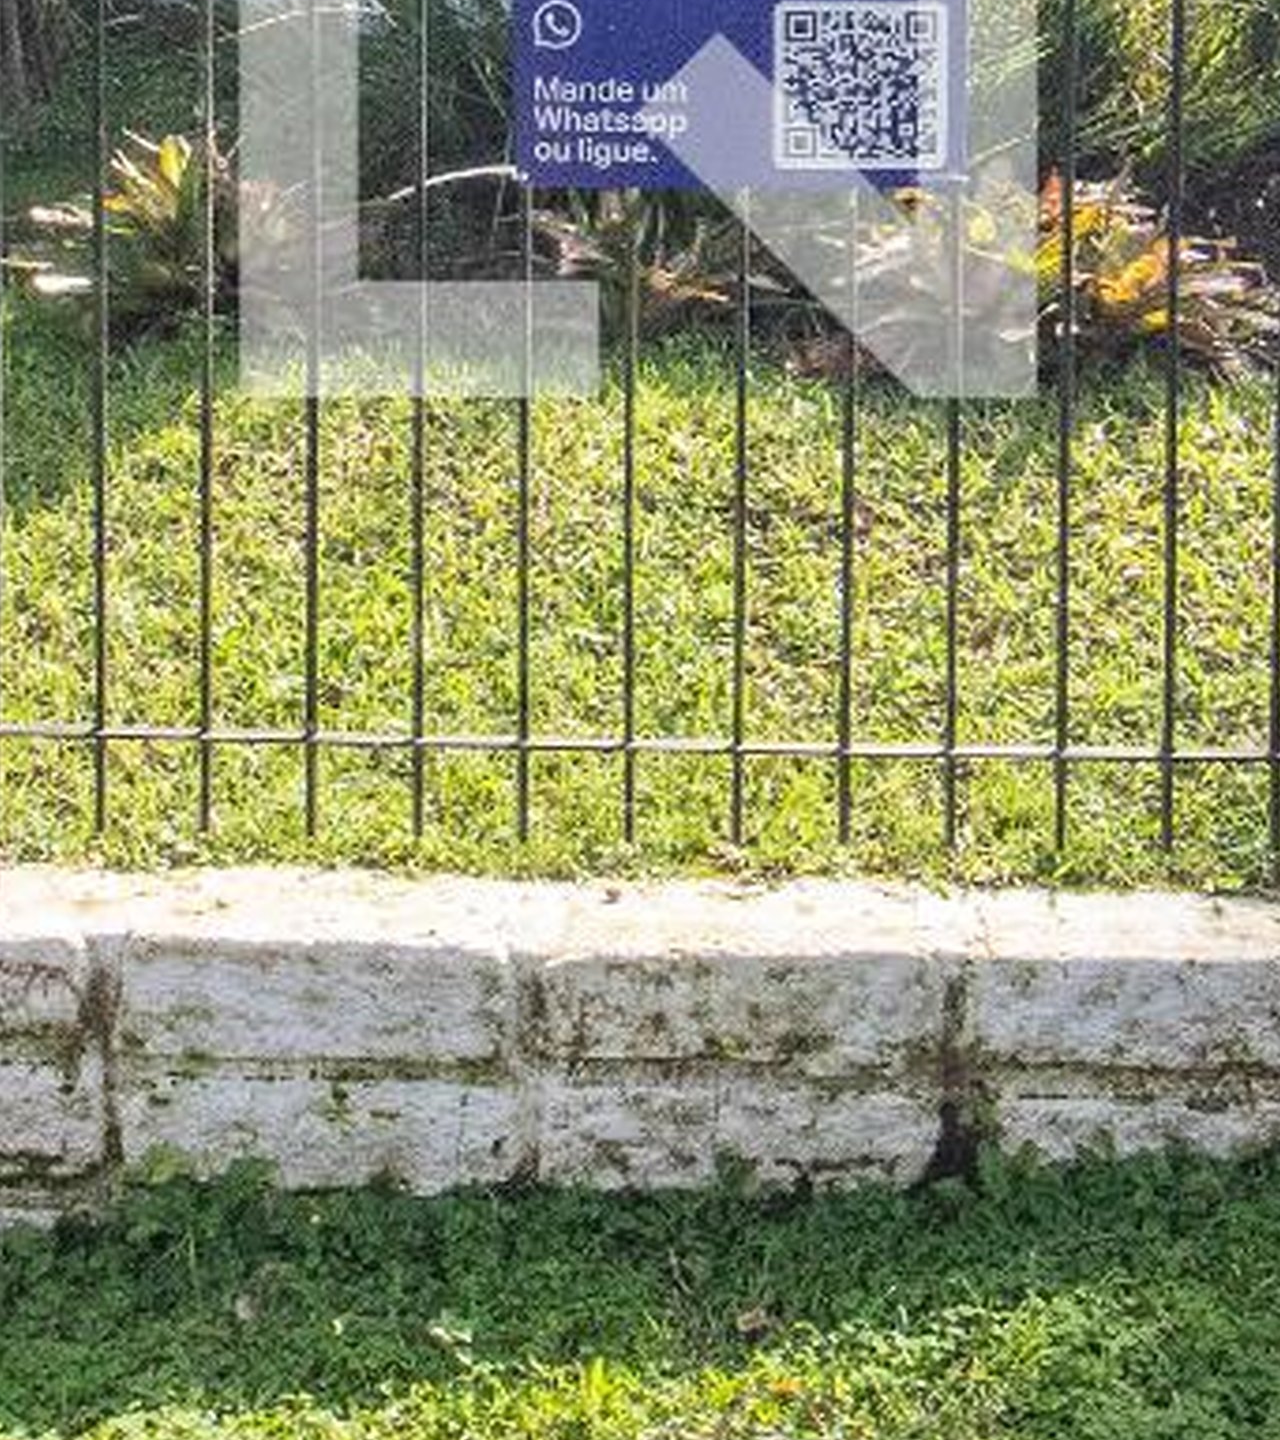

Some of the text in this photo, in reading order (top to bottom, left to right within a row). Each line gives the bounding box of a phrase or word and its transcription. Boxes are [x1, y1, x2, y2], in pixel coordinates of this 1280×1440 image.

[534, 76, 688, 103] Mande um
[534, 105, 688, 140] Whatsapp
[534, 137, 659, 170] ou ligue.
